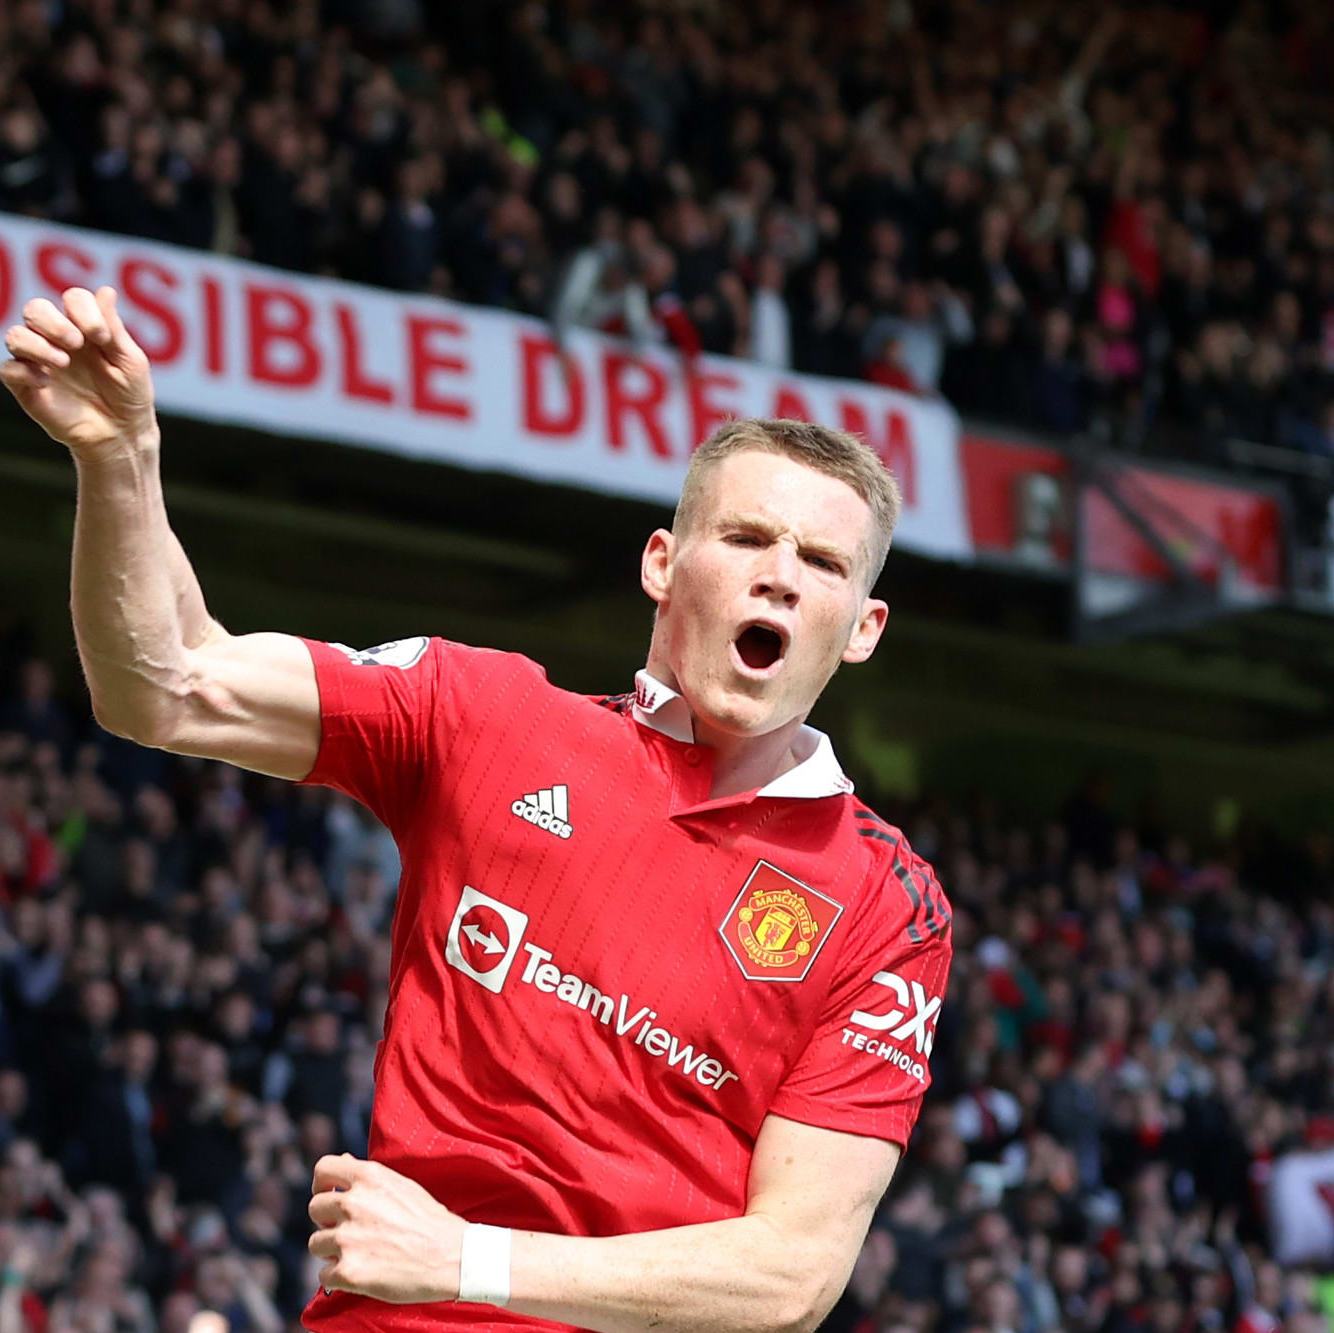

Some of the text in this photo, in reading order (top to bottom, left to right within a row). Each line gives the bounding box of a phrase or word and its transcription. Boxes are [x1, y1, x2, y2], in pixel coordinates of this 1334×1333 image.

[510, 799, 573, 839] adidas
[754, 893, 813, 935] MANCHESTER
[743, 936, 784, 964] UNITED
[521, 941, 740, 1091] TeamViewer
[841, 1028, 925, 1085] TECHNOLO
